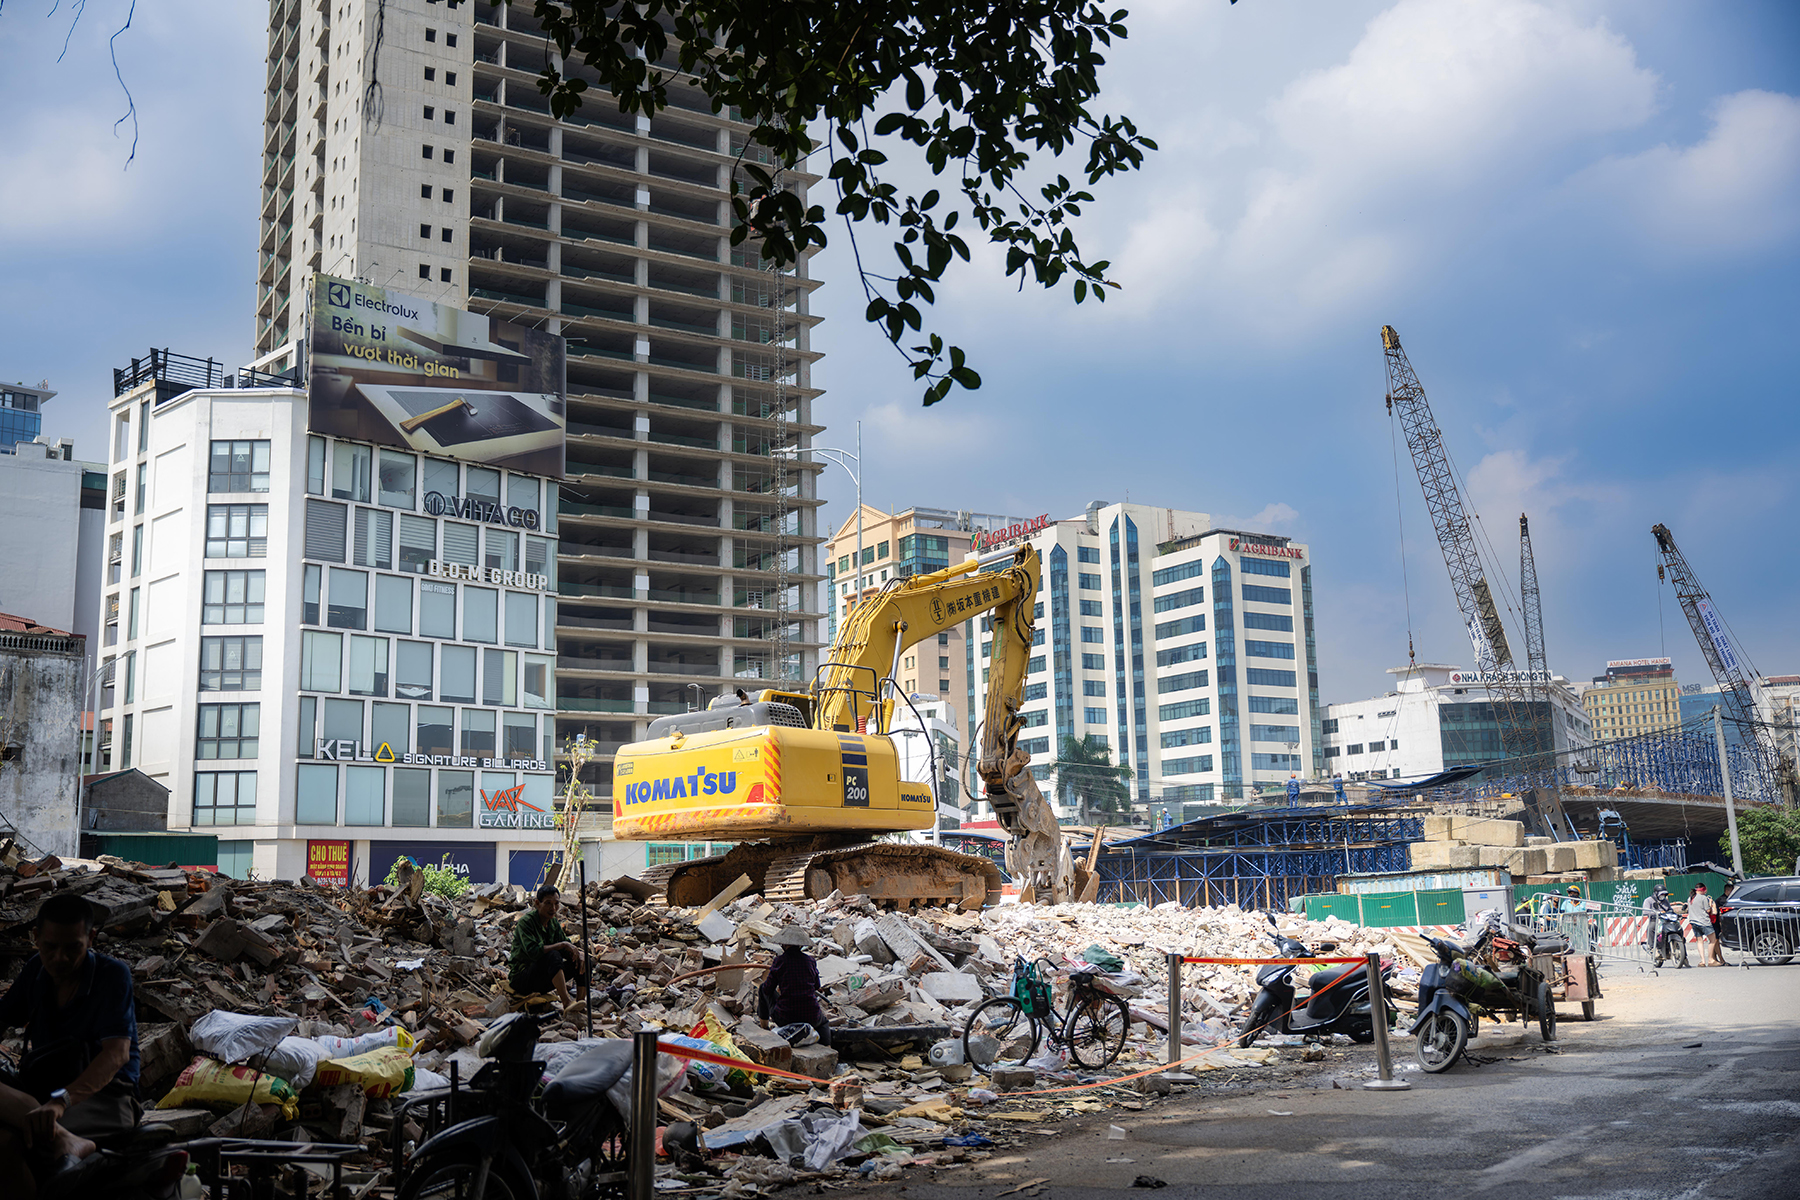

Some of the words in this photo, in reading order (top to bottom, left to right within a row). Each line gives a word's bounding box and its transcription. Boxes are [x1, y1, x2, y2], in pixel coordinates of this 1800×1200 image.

[354, 292, 418, 320] Electrolux
[331, 315, 364, 336] Bền
[371, 324, 387, 341] bỉ
[343, 343, 382, 363] vượt
[387, 349, 418, 370] thời
[423, 360, 459, 379] gian
[450, 495, 540, 532] VITACO
[983, 513, 1050, 548] AGRIBANK
[1242, 543, 1304, 560] AGRIBANK
[428, 558, 482, 582] D.O.M
[491, 567, 548, 591] GROUP
[1461, 671, 1479, 682] NHÀ
[1682, 683, 1701, 693] MSB
[403, 753, 477, 768] SIGNATURE
[482, 757, 547, 771] BILLIARDS
[625, 765, 737, 806] KOMATSU
[846, 775, 857, 786] PC
[847, 787, 867, 800] 200
[900, 792, 931, 804] KOMATSU
[479, 813, 555, 829] GAMING
[310, 845, 327, 862] CHO
[328, 842, 347, 862] THUÊ
